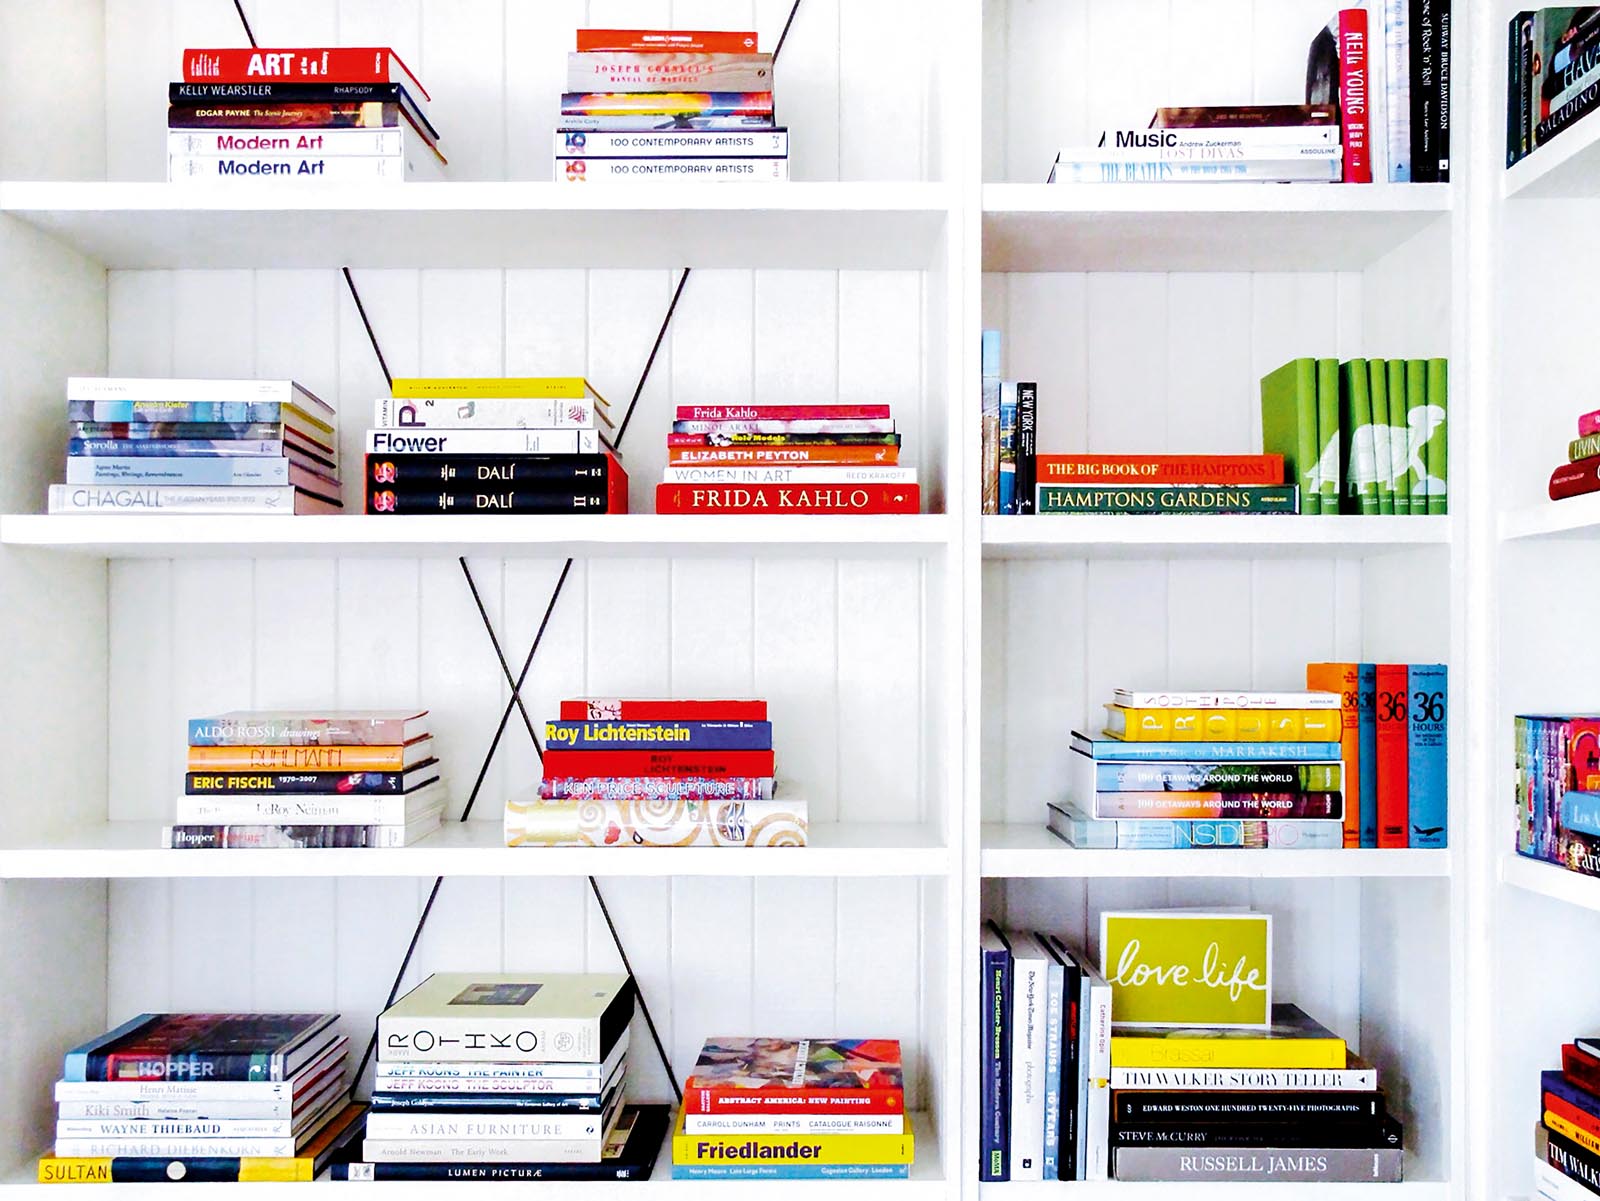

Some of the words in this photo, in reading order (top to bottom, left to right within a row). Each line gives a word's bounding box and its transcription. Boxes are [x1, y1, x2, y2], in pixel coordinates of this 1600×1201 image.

[1440, 13, 1449, 49] SUBWAY
[1344, 33, 1363, 64] NEIL
[1421, 29, 1432, 53] Rock
[247, 53, 295, 76] ART
[595, 65, 640, 73] JOSEPH
[1440, 51, 1449, 81] BRUCE
[1421, 67, 1432, 86] Roll
[179, 86, 208, 95] KELLY
[211, 86, 272, 95] WEARSTLER
[1346, 71, 1364, 114] YOUNG
[1440, 82, 1449, 130] DAVIDSON
[1540, 84, 1598, 137] SALADINO
[218, 135, 289, 150] Modern
[297, 135, 323, 150] Art
[632, 138, 712, 146] CONTEMPORARY
[716, 138, 754, 146] ARTISTS
[1116, 130, 1177, 148] Music
[1200, 149, 1244, 159] DIVAS
[219, 160, 291, 175] Modern
[298, 160, 325, 175] Art
[716, 165, 754, 173] ARTISTS
[1022, 390, 1034, 409] NEW
[694, 407, 722, 418] Frida
[726, 407, 758, 418] Kahlo
[1022, 410, 1034, 431] YORK
[83, 441, 118, 450] Sorolla
[374, 433, 447, 452] Flower
[681, 451, 753, 461] ELIZABETH
[757, 451, 809, 461] PEYTON
[477, 463, 516, 480] DALÍ
[675, 470, 737, 482] WOMEN
[743, 470, 757, 482] IN
[762, 470, 793, 482] ART
[1047, 463, 1074, 475] THE
[1077, 463, 1100, 476] BIG
[1102, 463, 1138, 476] BOOK
[1141, 463, 1159, 476] OF
[1162, 463, 1189, 476] THE
[1191, 463, 1265, 476] HAMPTONS
[73, 490, 163, 507] CHAGALL
[476, 492, 516, 508] DALÍ
[692, 490, 769, 508] FRIDA
[778, 490, 869, 508] KAHLO
[1048, 492, 1154, 507] HAMPTONS
[1160, 492, 1250, 507] GARDENS
[1343, 691, 1358, 708] 36
[1379, 691, 1406, 722] 36
[1413, 692, 1444, 722] 36
[194, 727, 233, 738] ALDO
[238, 727, 275, 738] ROSSI
[280, 727, 321, 739] drawings
[545, 724, 579, 745] Roy
[584, 723, 691, 742] Lichtenstein
[1413, 723, 1444, 731] HOURS
[1211, 746, 1308, 757] MARRAKESH
[644, 765, 726, 773] LICHTENSTEIN
[193, 777, 224, 789] ERIC
[228, 777, 275, 789] FISCHL
[1155, 774, 1201, 783] GETAWAYS
[1203, 774, 1240, 783] AROUND
[1242, 774, 1259, 783] THE
[1261, 774, 1293, 783] WORLD
[563, 782, 594, 795] KEN
[597, 782, 641, 795] PRICE
[646, 782, 736, 795] SCULPTURE
[1155, 800, 1201, 809] GETAWAYS
[1203, 800, 1240, 809] AROUND
[1242, 800, 1259, 809] THE
[1261, 800, 1293, 809] WORLD
[176, 831, 215, 844] Hopper
[1108, 939, 1191, 987] love
[1193, 942, 1268, 1002] life
[388, 1030, 537, 1051] ROTHKO
[1048, 1019, 1057, 1073] STRAUSS
[138, 1061, 214, 1077] HOPPER
[387, 1079, 414, 1089] JEFF
[418, 1079, 459, 1089] KOONS
[466, 1079, 489, 1089] THE
[492, 1079, 553, 1090] SCULPTOR
[1123, 1072, 1151, 1085] TIM
[1156, 1072, 1224, 1085] WALKER
[1230, 1072, 1278, 1086] STORY
[1283, 1072, 1342, 1086] TELLER
[830, 1097, 871, 1105] PAINTING
[1049, 1091, 1056, 1104] 10
[85, 1104, 111, 1116] Kiki
[113, 1104, 150, 1116] Smith
[100, 1124, 149, 1134] WAYNE
[152, 1125, 221, 1134] THIEBAUD
[410, 1124, 459, 1135] ASIAN
[467, 1124, 563, 1135] FURNITURE
[854, 1119, 893, 1128] RAISONNÉ
[1046, 1106, 1056, 1147] YEARS
[1118, 1132, 1154, 1141] STEVE
[1156, 1132, 1207, 1142] McCURRY
[90, 1144, 160, 1155] RICHARD
[381, 1148, 406, 1156] Arnold
[451, 1148, 465, 1156] The
[467, 1148, 488, 1156] Early
[489, 1148, 508, 1156] Work
[697, 1142, 822, 1159] Friedlander
[992, 1152, 1001, 1174] MoMA
[1180, 1157, 1263, 1172] RUSSELL
[1267, 1157, 1327, 1174] JAMES
[1549, 1142, 1567, 1166] TIM
[1570, 1155, 1600, 1188] WALK
[44, 1165, 108, 1181] SULTAN
[492, 1169, 542, 1177] PICTURÆ
